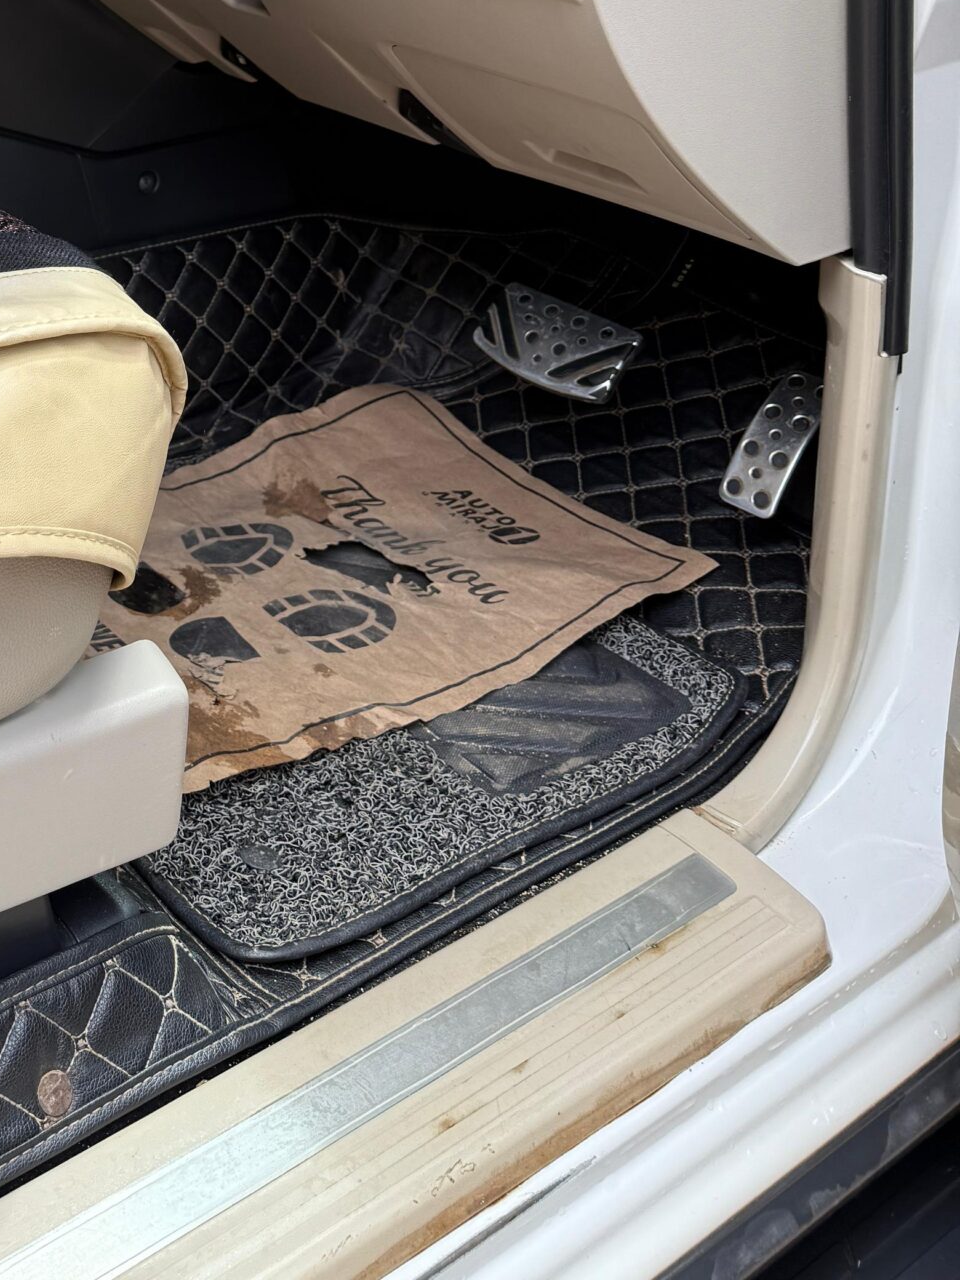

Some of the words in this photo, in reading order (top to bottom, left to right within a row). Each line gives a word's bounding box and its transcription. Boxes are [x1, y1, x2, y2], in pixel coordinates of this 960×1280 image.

[430, 491, 501, 530] MIRAJ
[452, 490, 516, 525] AUTO
[320, 475, 446, 556] Thank
[424, 557, 510, 604] you
